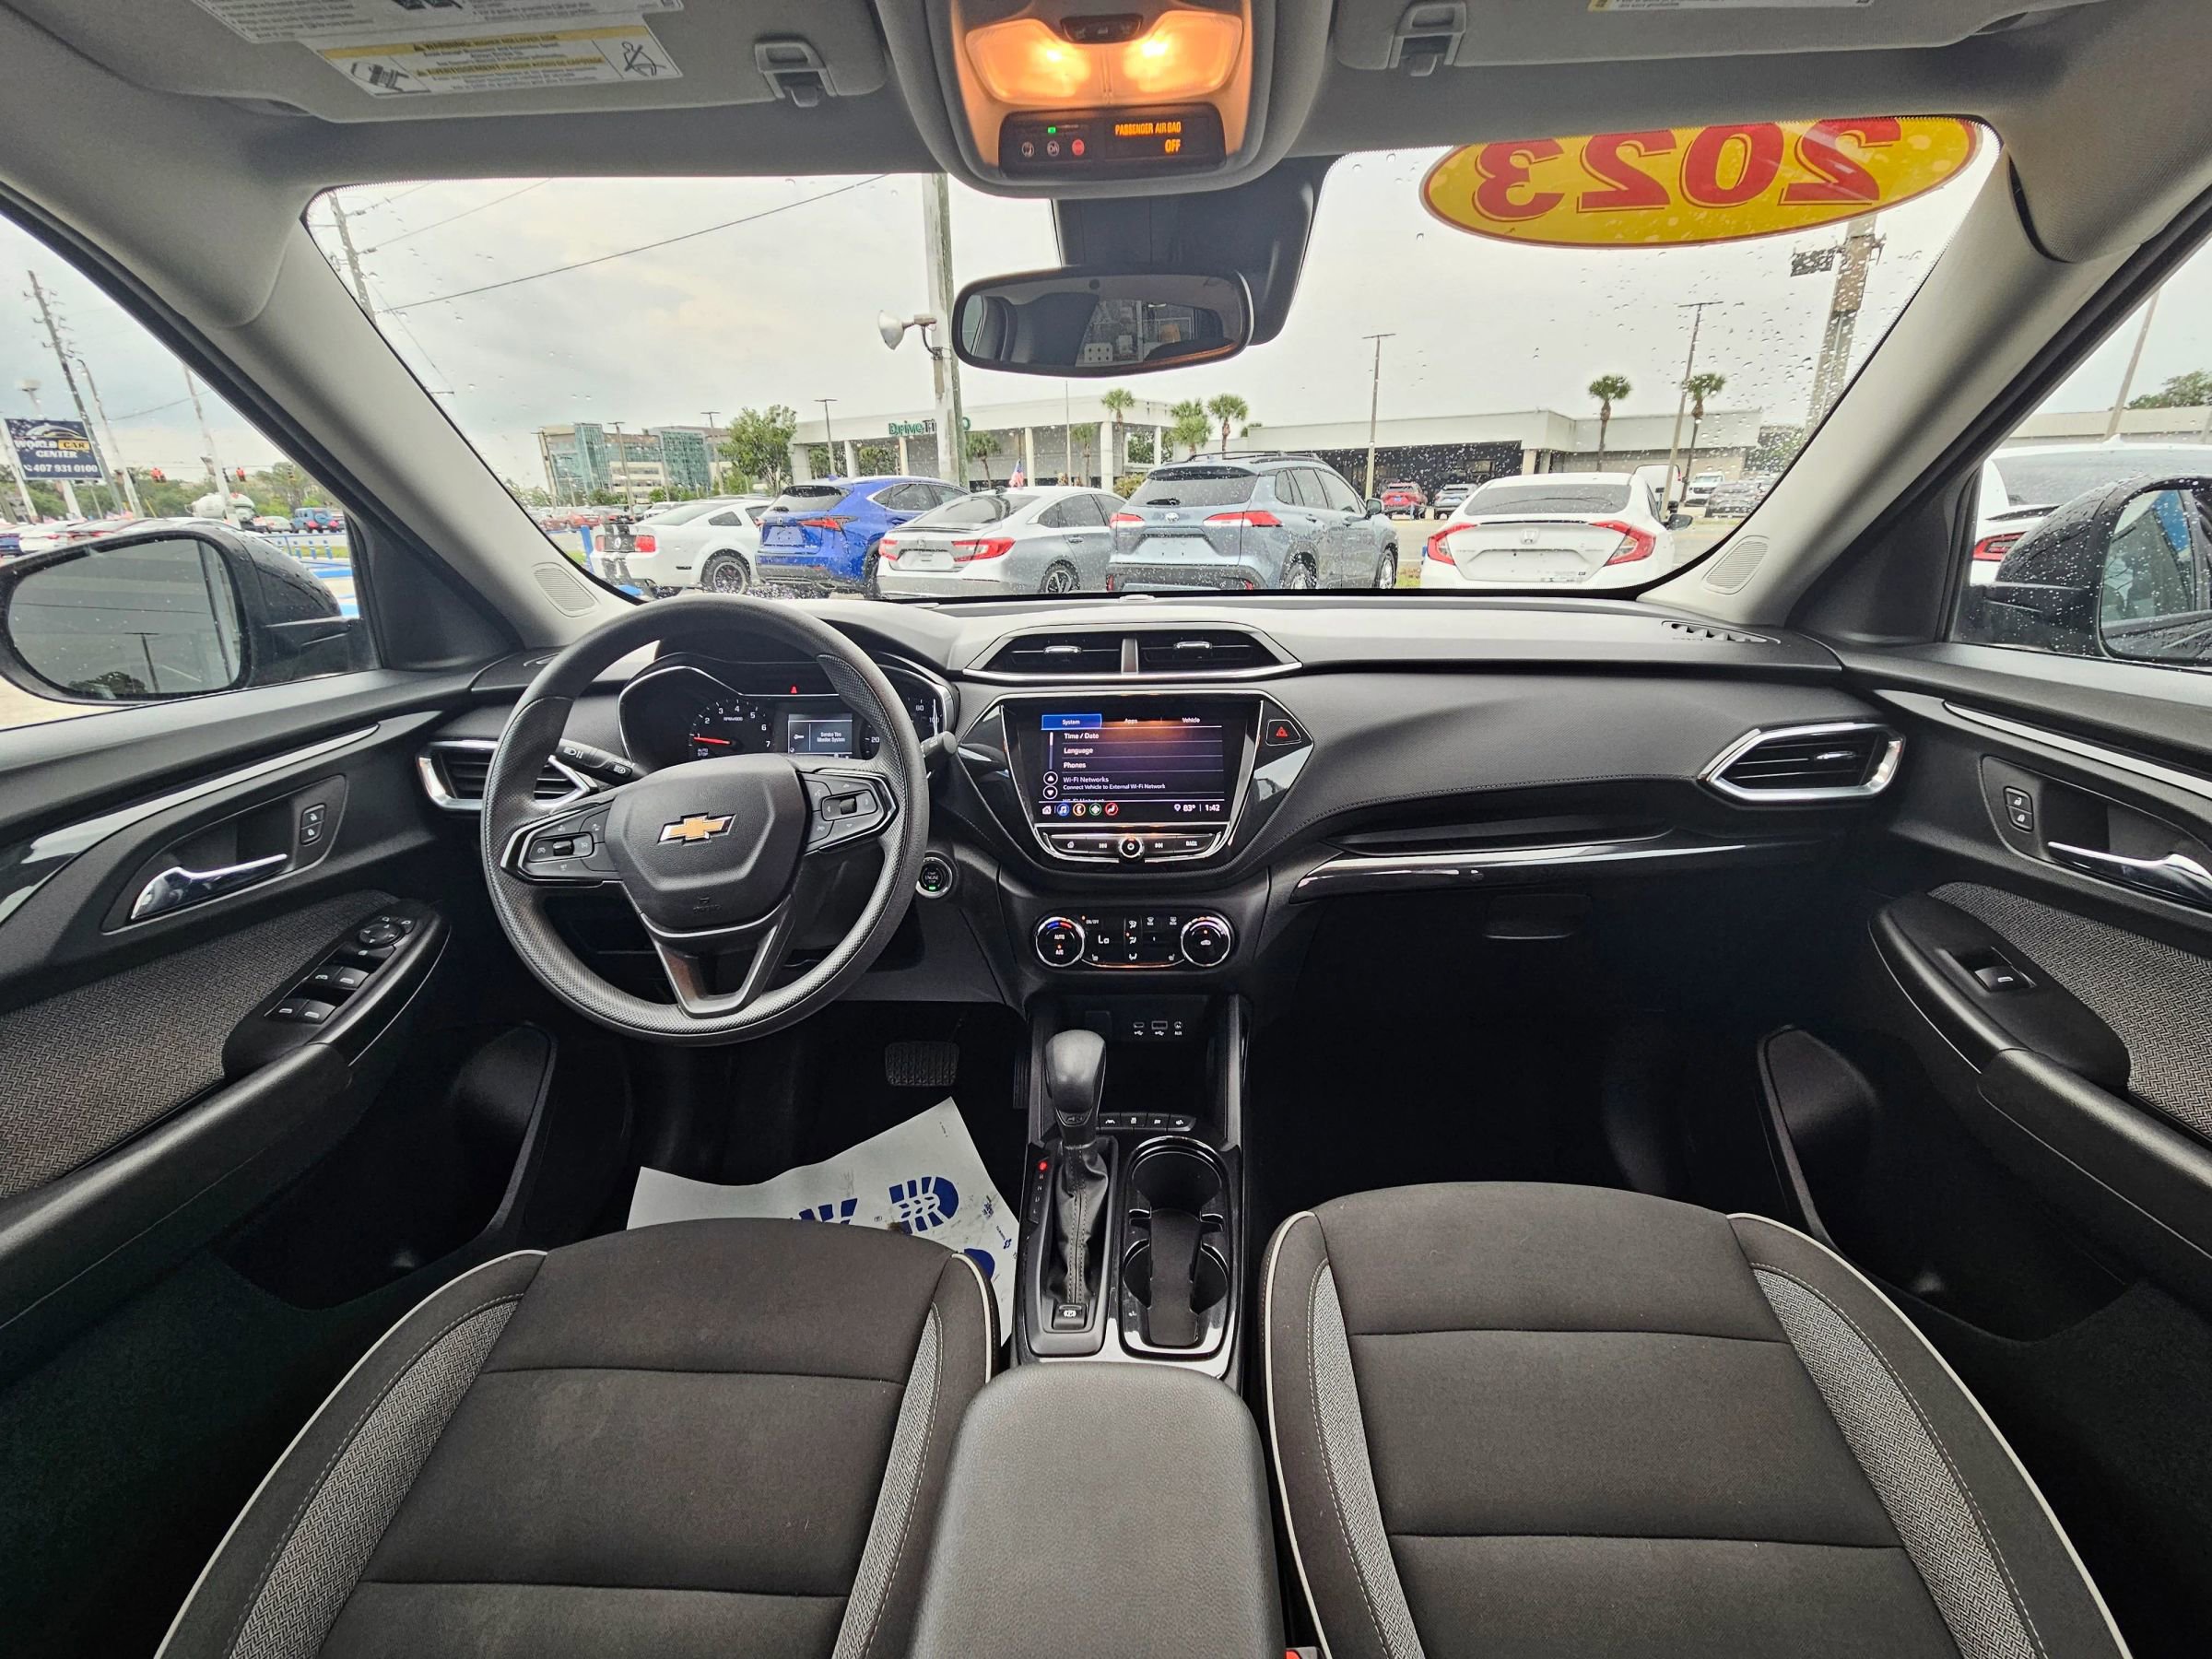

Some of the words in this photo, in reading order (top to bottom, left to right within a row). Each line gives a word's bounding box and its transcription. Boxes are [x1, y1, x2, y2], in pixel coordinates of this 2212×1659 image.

[1115, 123, 1153, 136] PASSENGER
[1155, 122, 1166, 135] AIR
[1167, 121, 1182, 134] BAG
[1164, 138, 1182, 154] OFF
[14, 440, 58, 449] WORLD
[35, 450, 78, 458] CENTER
[33, 464, 52, 472] 407
[54, 464, 72, 472] 931
[74, 464, 98, 472] 0100
[1064, 747, 1094, 755] Language
[1205, 804, 1220, 812] 1:42
